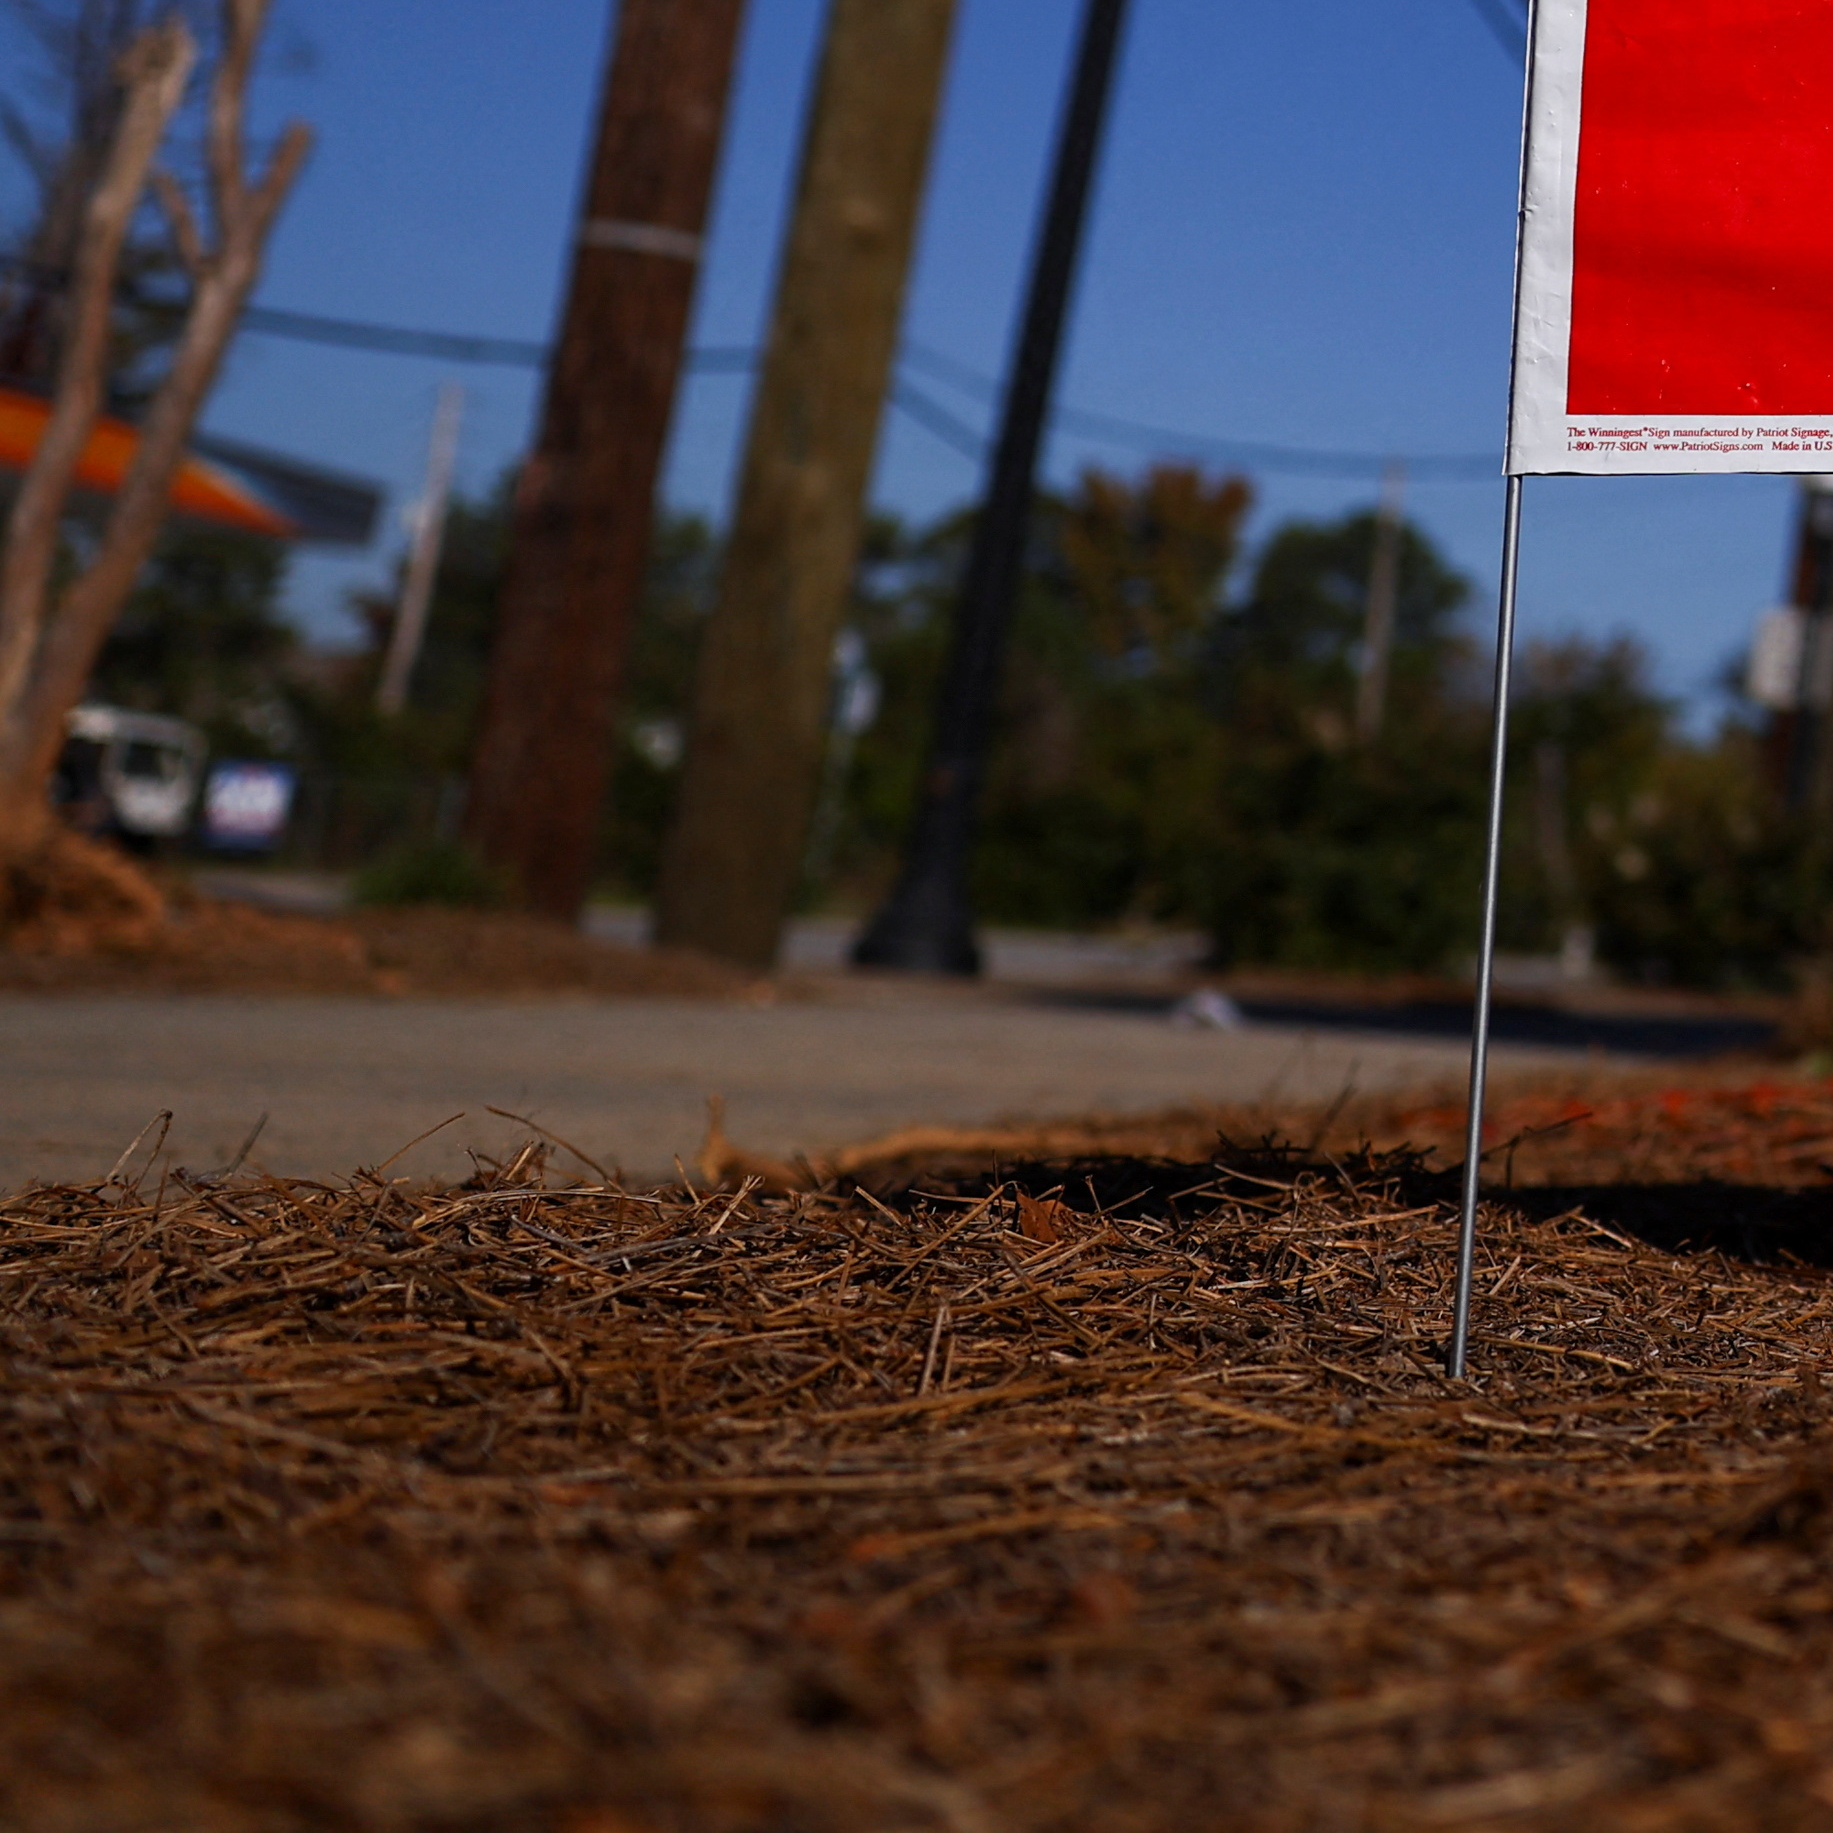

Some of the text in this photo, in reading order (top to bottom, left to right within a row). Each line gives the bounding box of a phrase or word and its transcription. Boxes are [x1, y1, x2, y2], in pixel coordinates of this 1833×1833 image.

[1567, 427, 1585, 437] The
[1673, 427, 1739, 437] manufactured
[1742, 427, 1754, 439] by
[1757, 427, 1789, 437] Patriot
[1791, 427, 1833, 439] Signage,
[1567, 441, 1648, 451] 1-800-777-SIGN
[1653, 441, 1763, 453] www.PatriotSigns.com
[1772, 441, 1799, 451] Made
[1802, 441, 1812, 451] in
